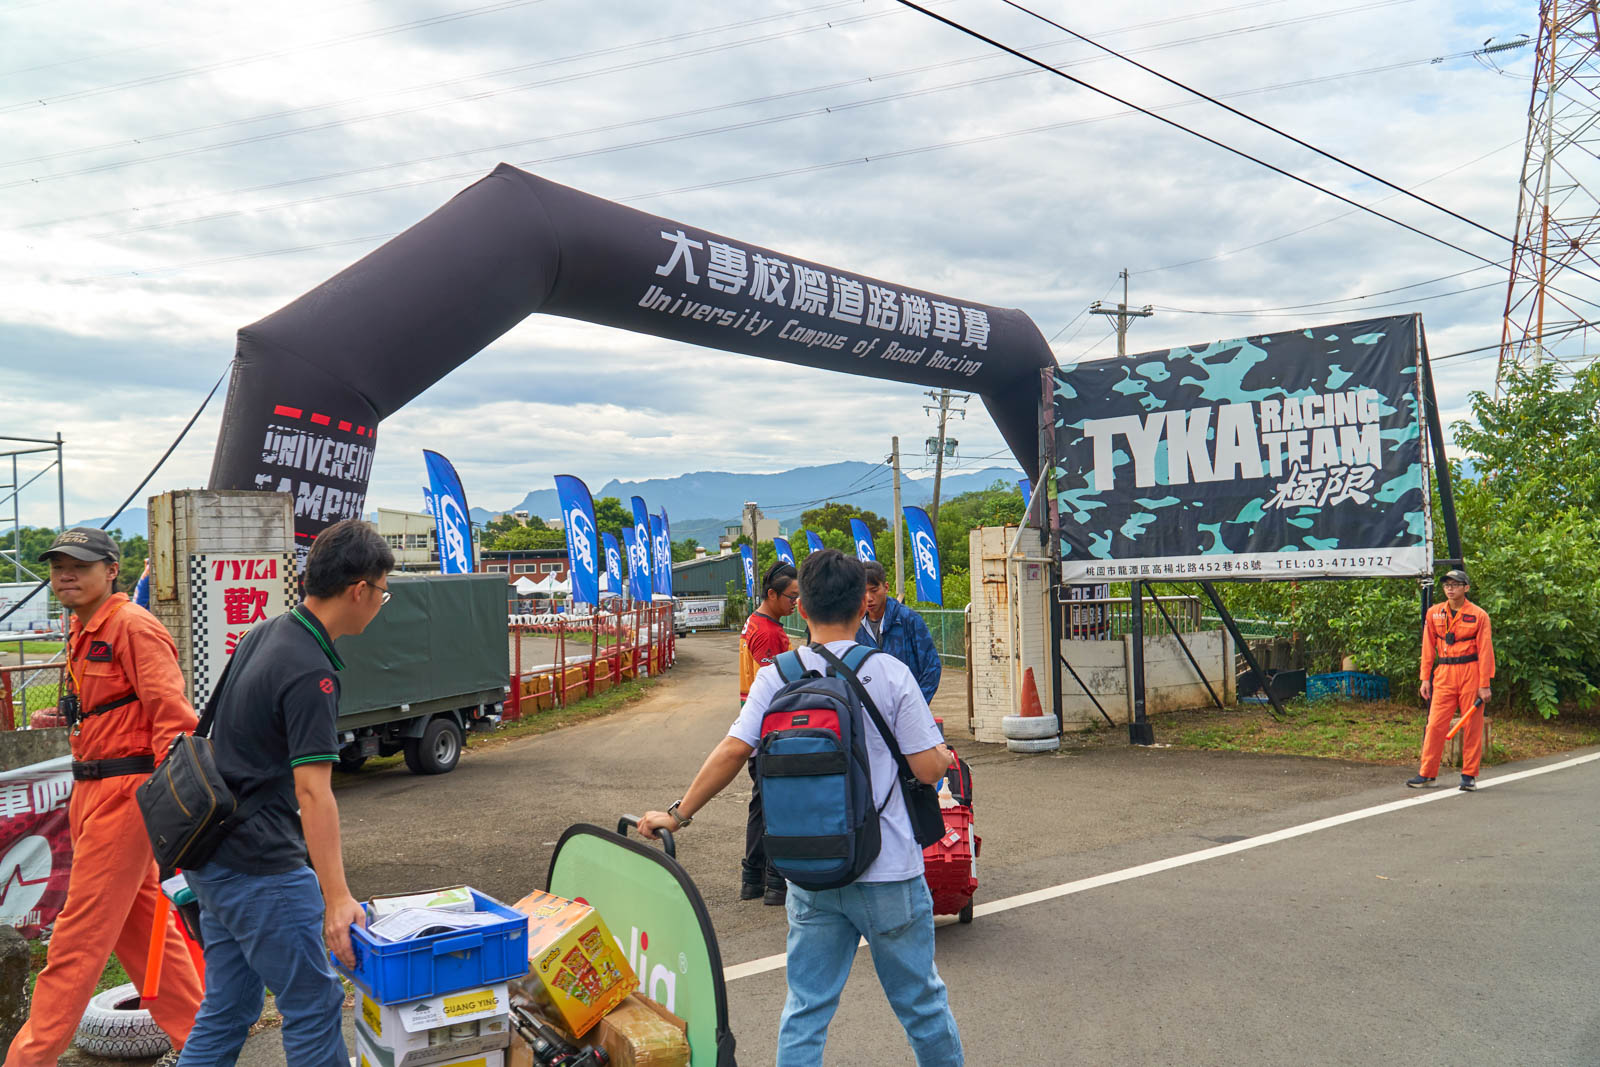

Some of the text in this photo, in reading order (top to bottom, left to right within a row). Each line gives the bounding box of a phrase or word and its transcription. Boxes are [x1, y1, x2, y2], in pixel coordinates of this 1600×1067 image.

[656, 230, 990, 350] 大專校際道路機車賽
[638, 285, 982, 376] University Campus of Road Racing
[1084, 389, 1380, 491] TYKA RACING
[1262, 423, 1382, 478] TEAM
[1262, 462, 1376, 510] 極限
[211, 559, 277, 581] TYKA
[1276, 556, 1392, 569] TEL:03-4719727
[443, 1001, 476, 1014] GUANG
[478, 997, 499, 1009] YING
